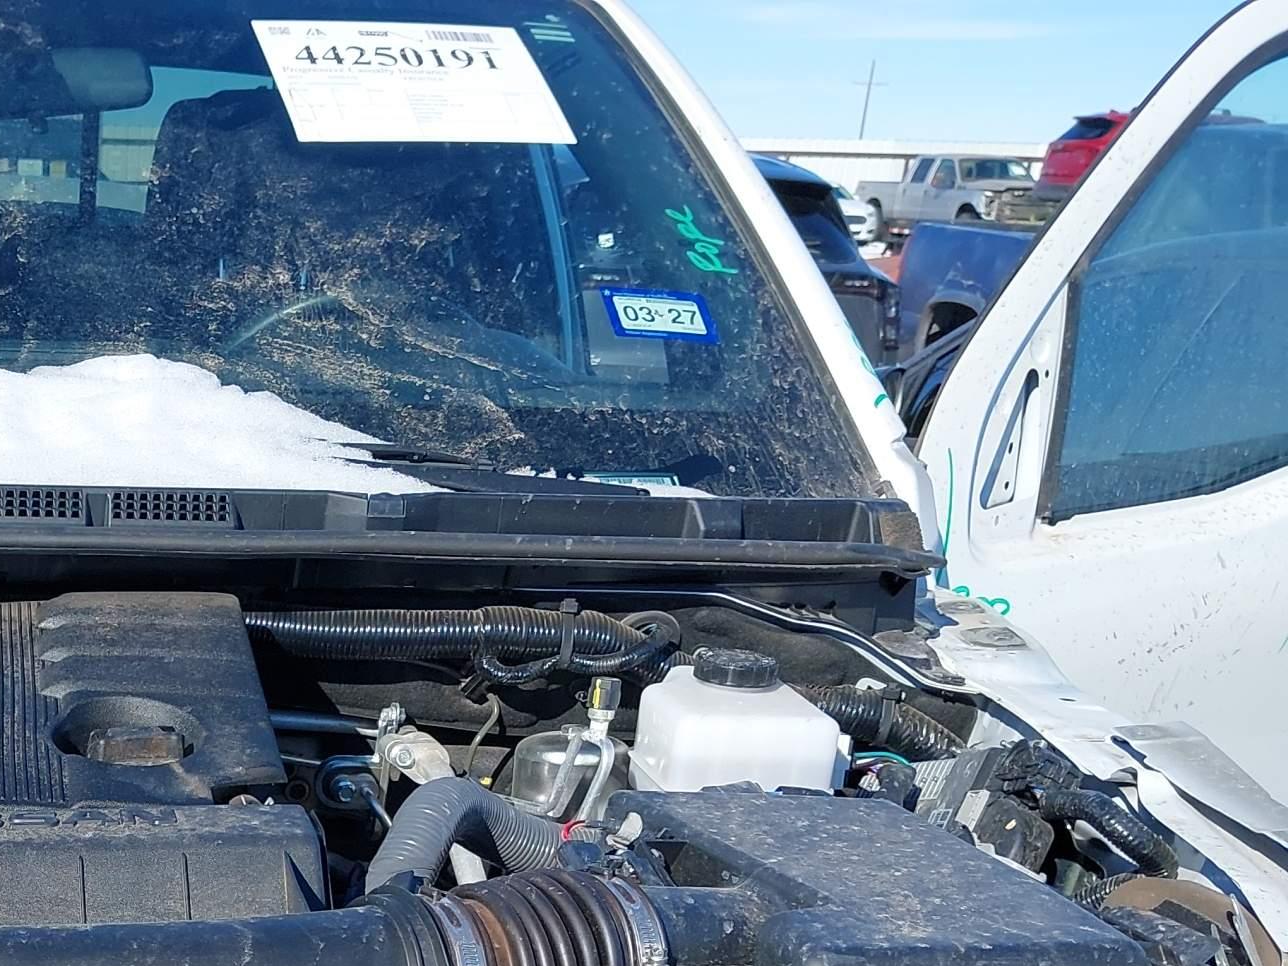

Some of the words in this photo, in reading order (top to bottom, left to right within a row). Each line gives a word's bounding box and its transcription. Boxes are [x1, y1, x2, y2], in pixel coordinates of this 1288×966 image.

[295, 44, 500, 70] 44250191
[623, 305, 656, 323] 03
[667, 308, 697, 325] 27
